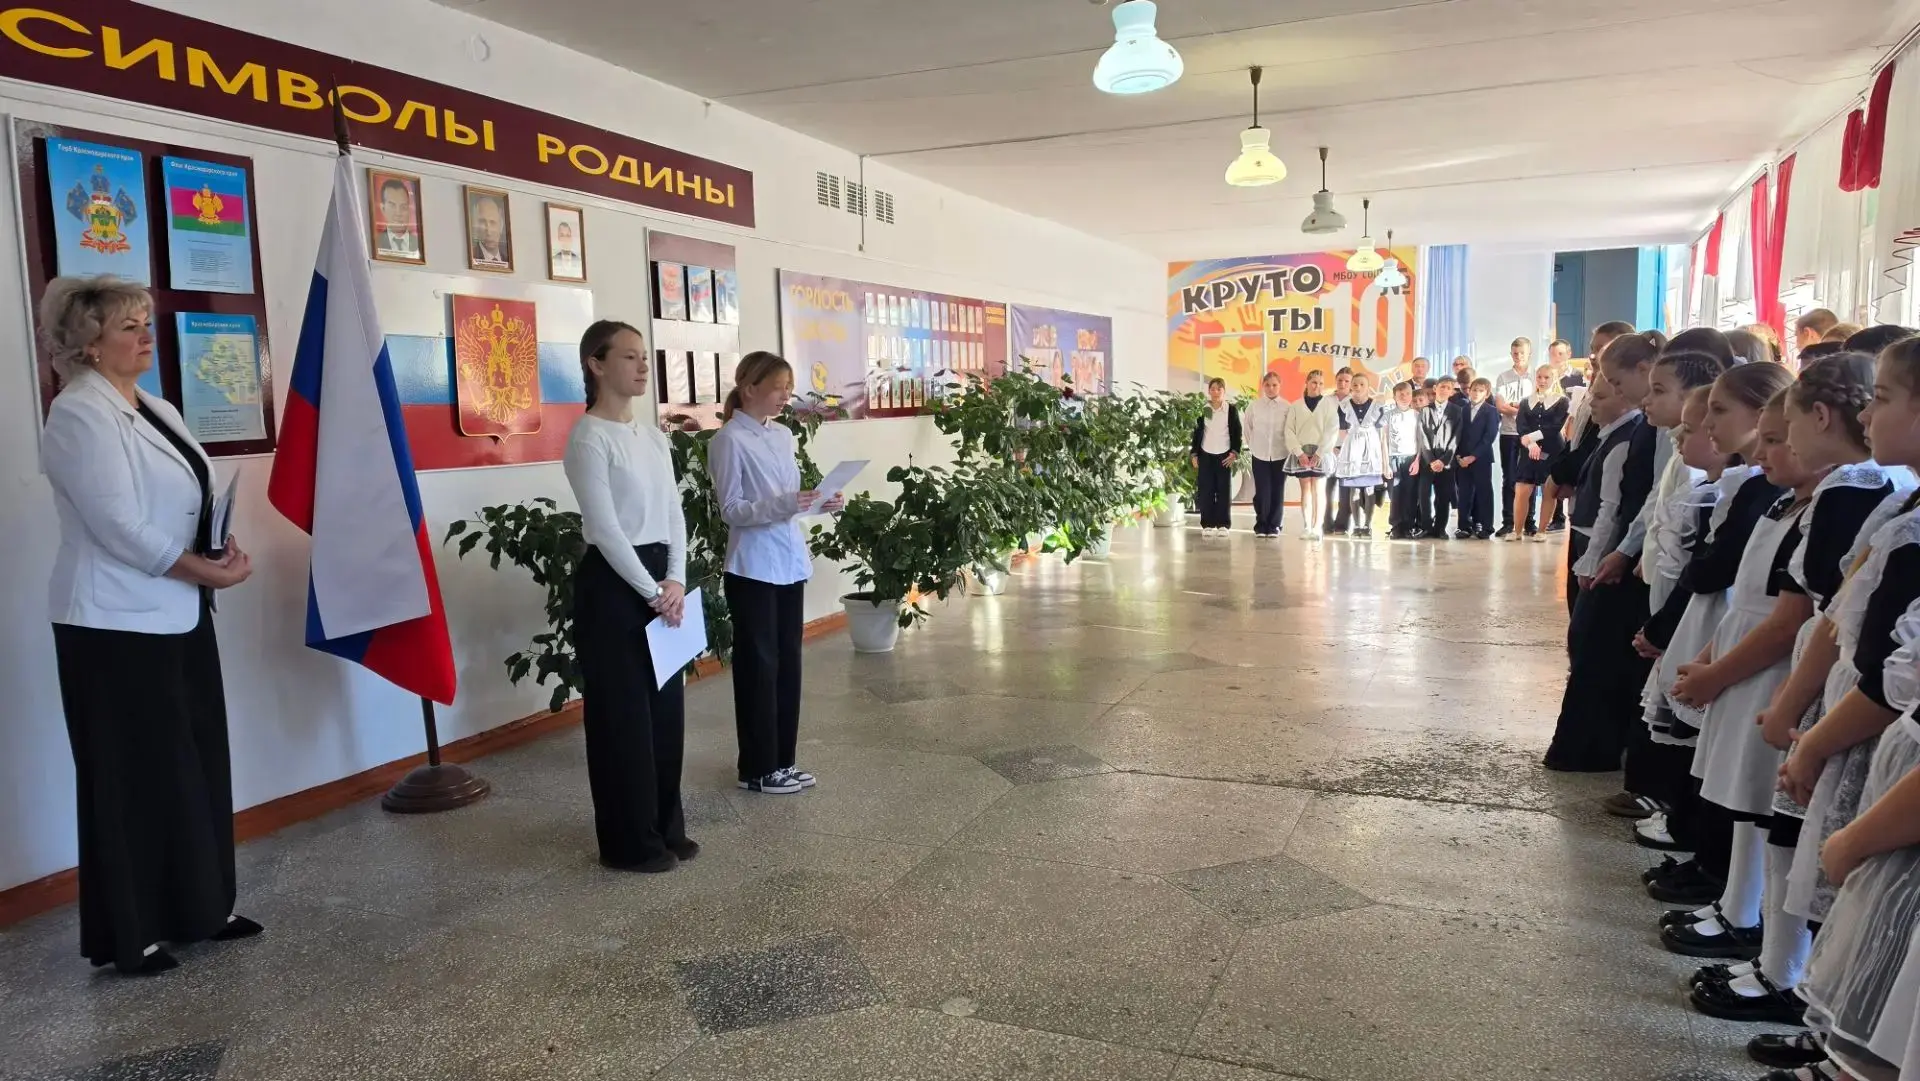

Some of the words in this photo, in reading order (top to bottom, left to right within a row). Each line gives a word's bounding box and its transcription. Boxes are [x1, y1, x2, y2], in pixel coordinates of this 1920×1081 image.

[0, 8, 495, 151] СИМВОЛЫ
[537, 134, 735, 208] РОДИНЫ
[1182, 265, 1323, 313] КРУТО
[1333, 271, 1358, 280] МБОУ
[1268, 307, 1323, 332] ТЫ
[1319, 281, 1406, 374] 10
[1278, 338, 1288, 349] В
[1297, 340, 1375, 358] ДЕСЯТКУ
